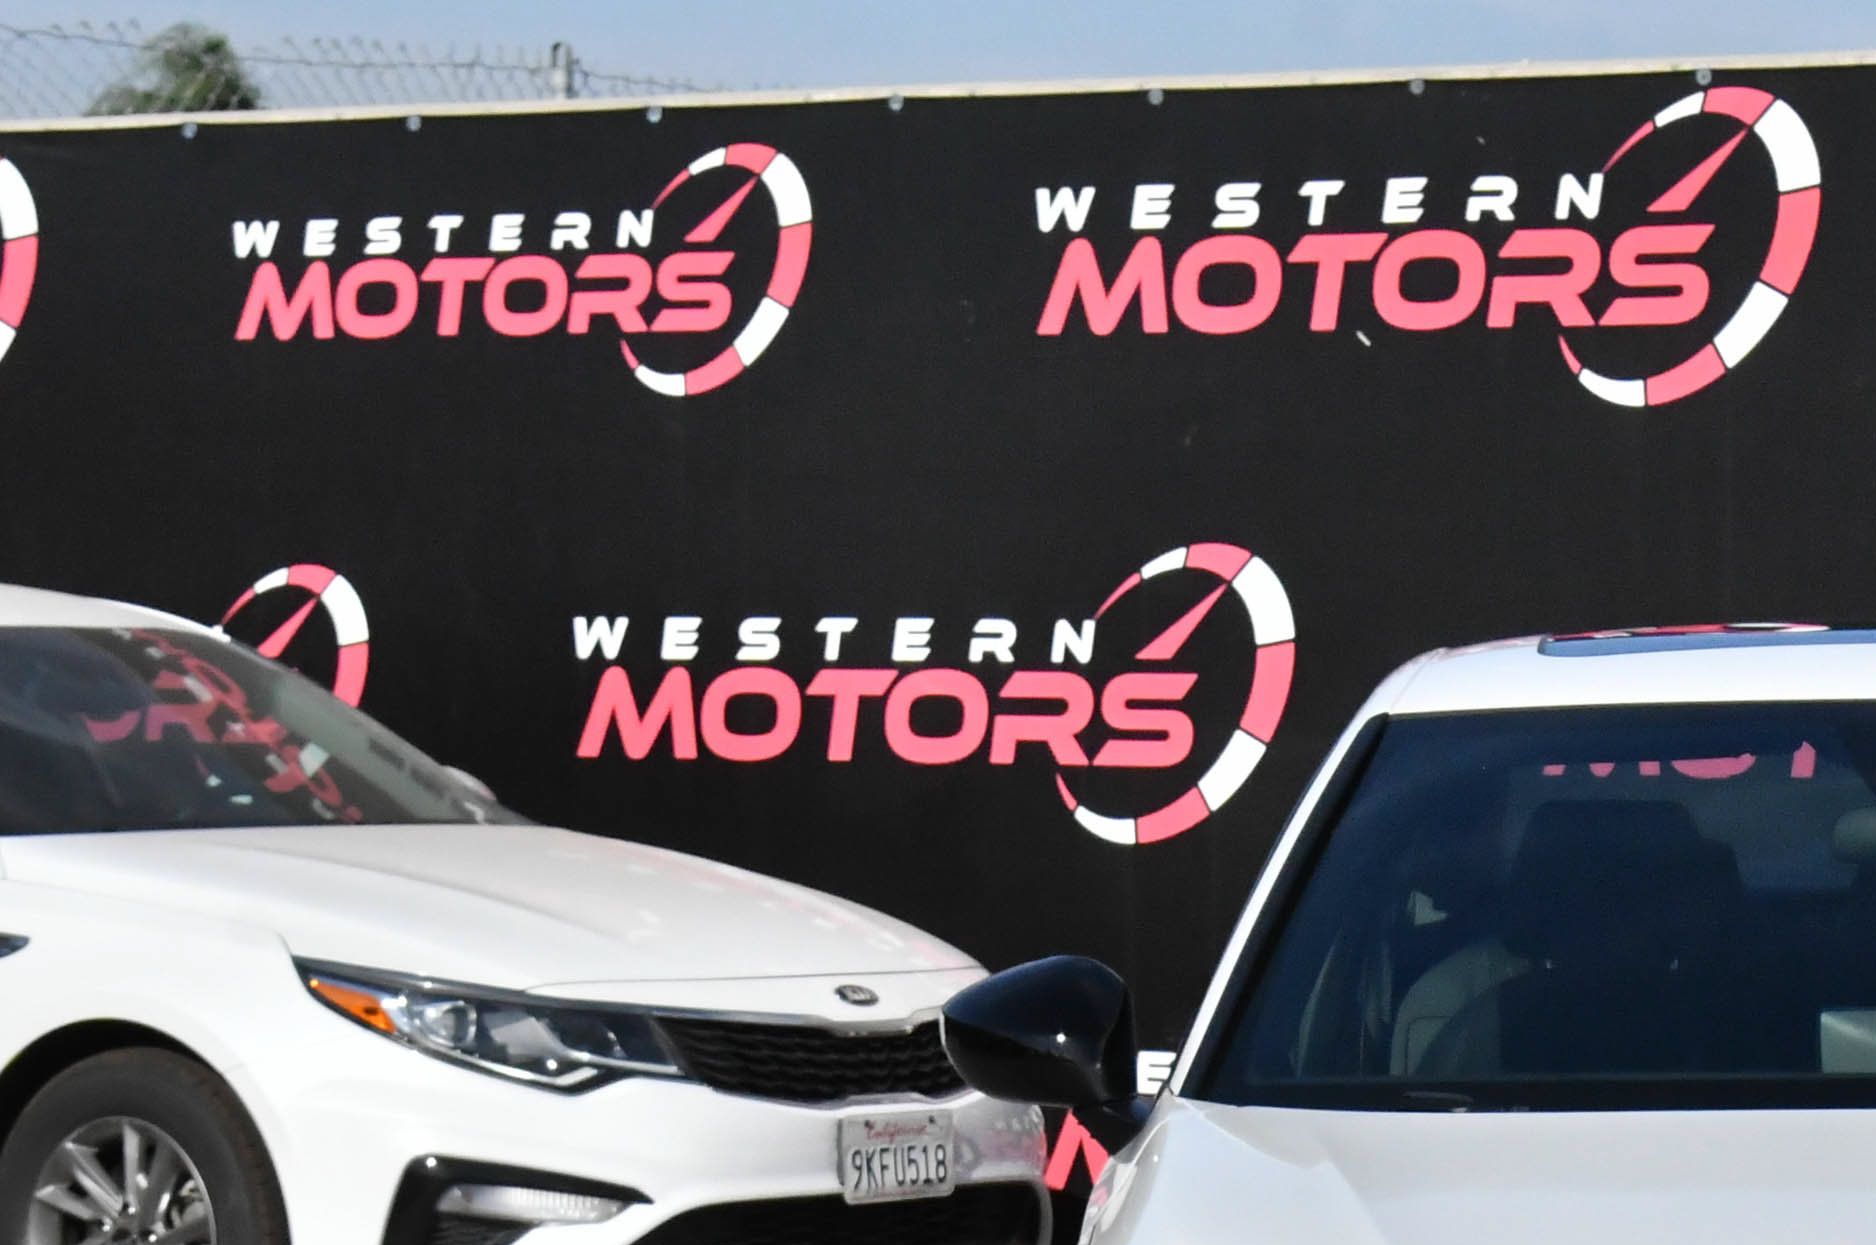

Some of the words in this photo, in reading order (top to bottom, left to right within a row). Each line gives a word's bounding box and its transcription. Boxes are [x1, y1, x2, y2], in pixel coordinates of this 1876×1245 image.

[1035, 172, 1605, 233] WESTERN
[232, 208, 654, 259] WESTERN
[234, 250, 735, 342] MOTORS
[1036, 223, 1716, 337] MOTORS
[573, 615, 1096, 664] WESTERN
[576, 665, 1199, 768] MOTORS
[851, 1143, 948, 1191] 9KFU518
